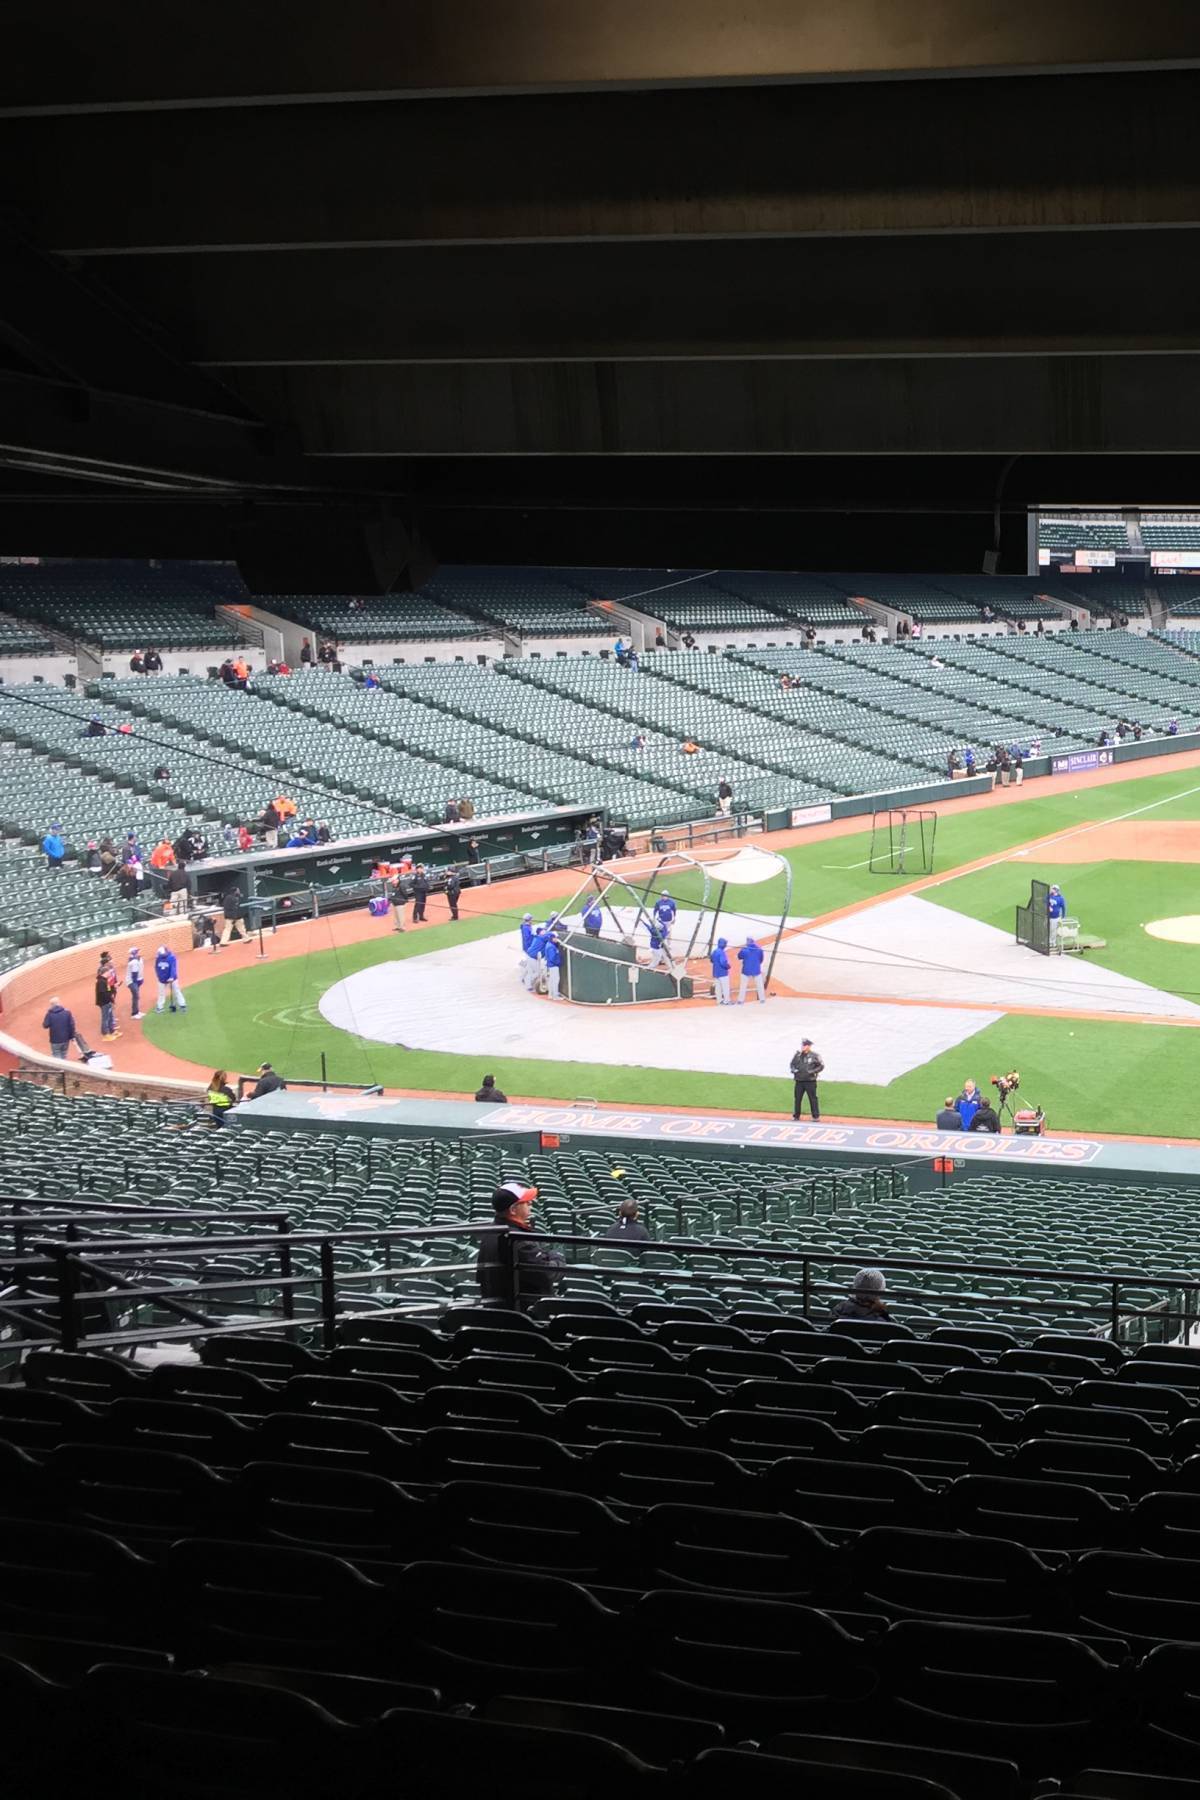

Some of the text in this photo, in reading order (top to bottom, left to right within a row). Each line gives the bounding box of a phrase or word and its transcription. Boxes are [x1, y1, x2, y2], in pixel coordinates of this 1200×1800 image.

[1070, 753, 1097, 765] SINCLAIR
[492, 1109, 1093, 1161] HOME OF THE ORIOLES
